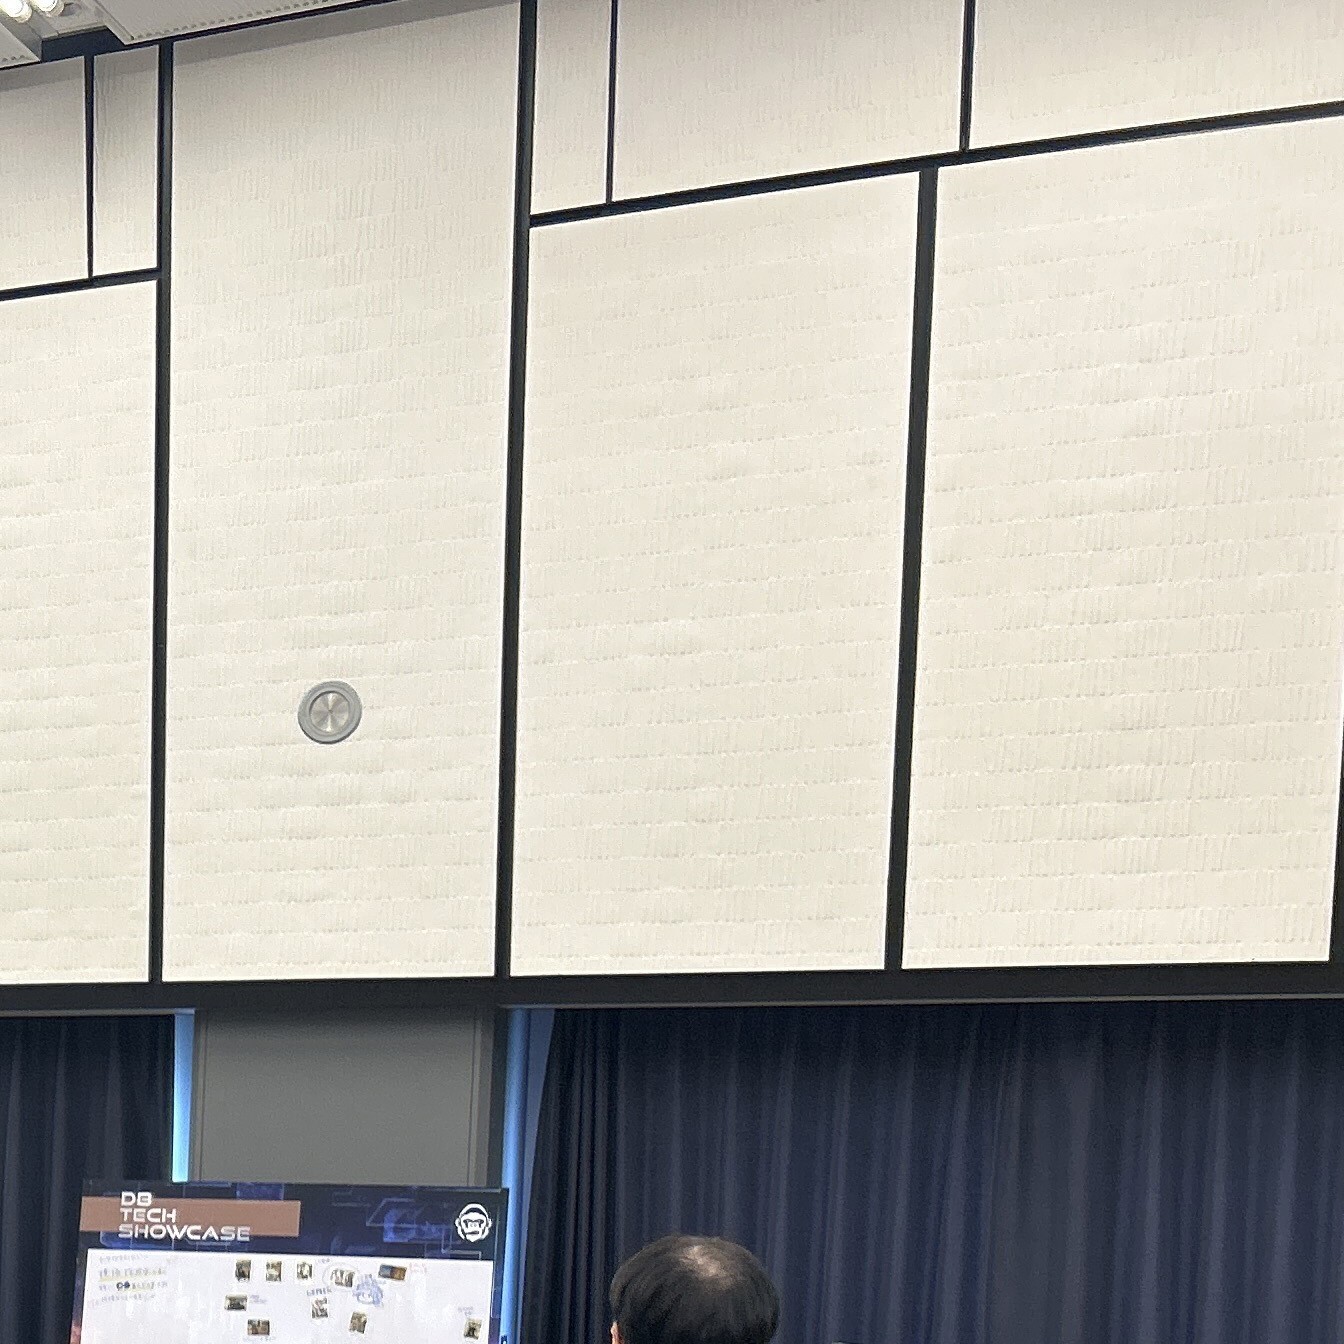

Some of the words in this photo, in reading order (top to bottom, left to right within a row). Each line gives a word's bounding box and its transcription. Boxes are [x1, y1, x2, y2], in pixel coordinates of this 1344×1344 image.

[120, 1191, 153, 1206] DB
[120, 1207, 176, 1223] TECH
[118, 1223, 250, 1242] SHOWCASE
